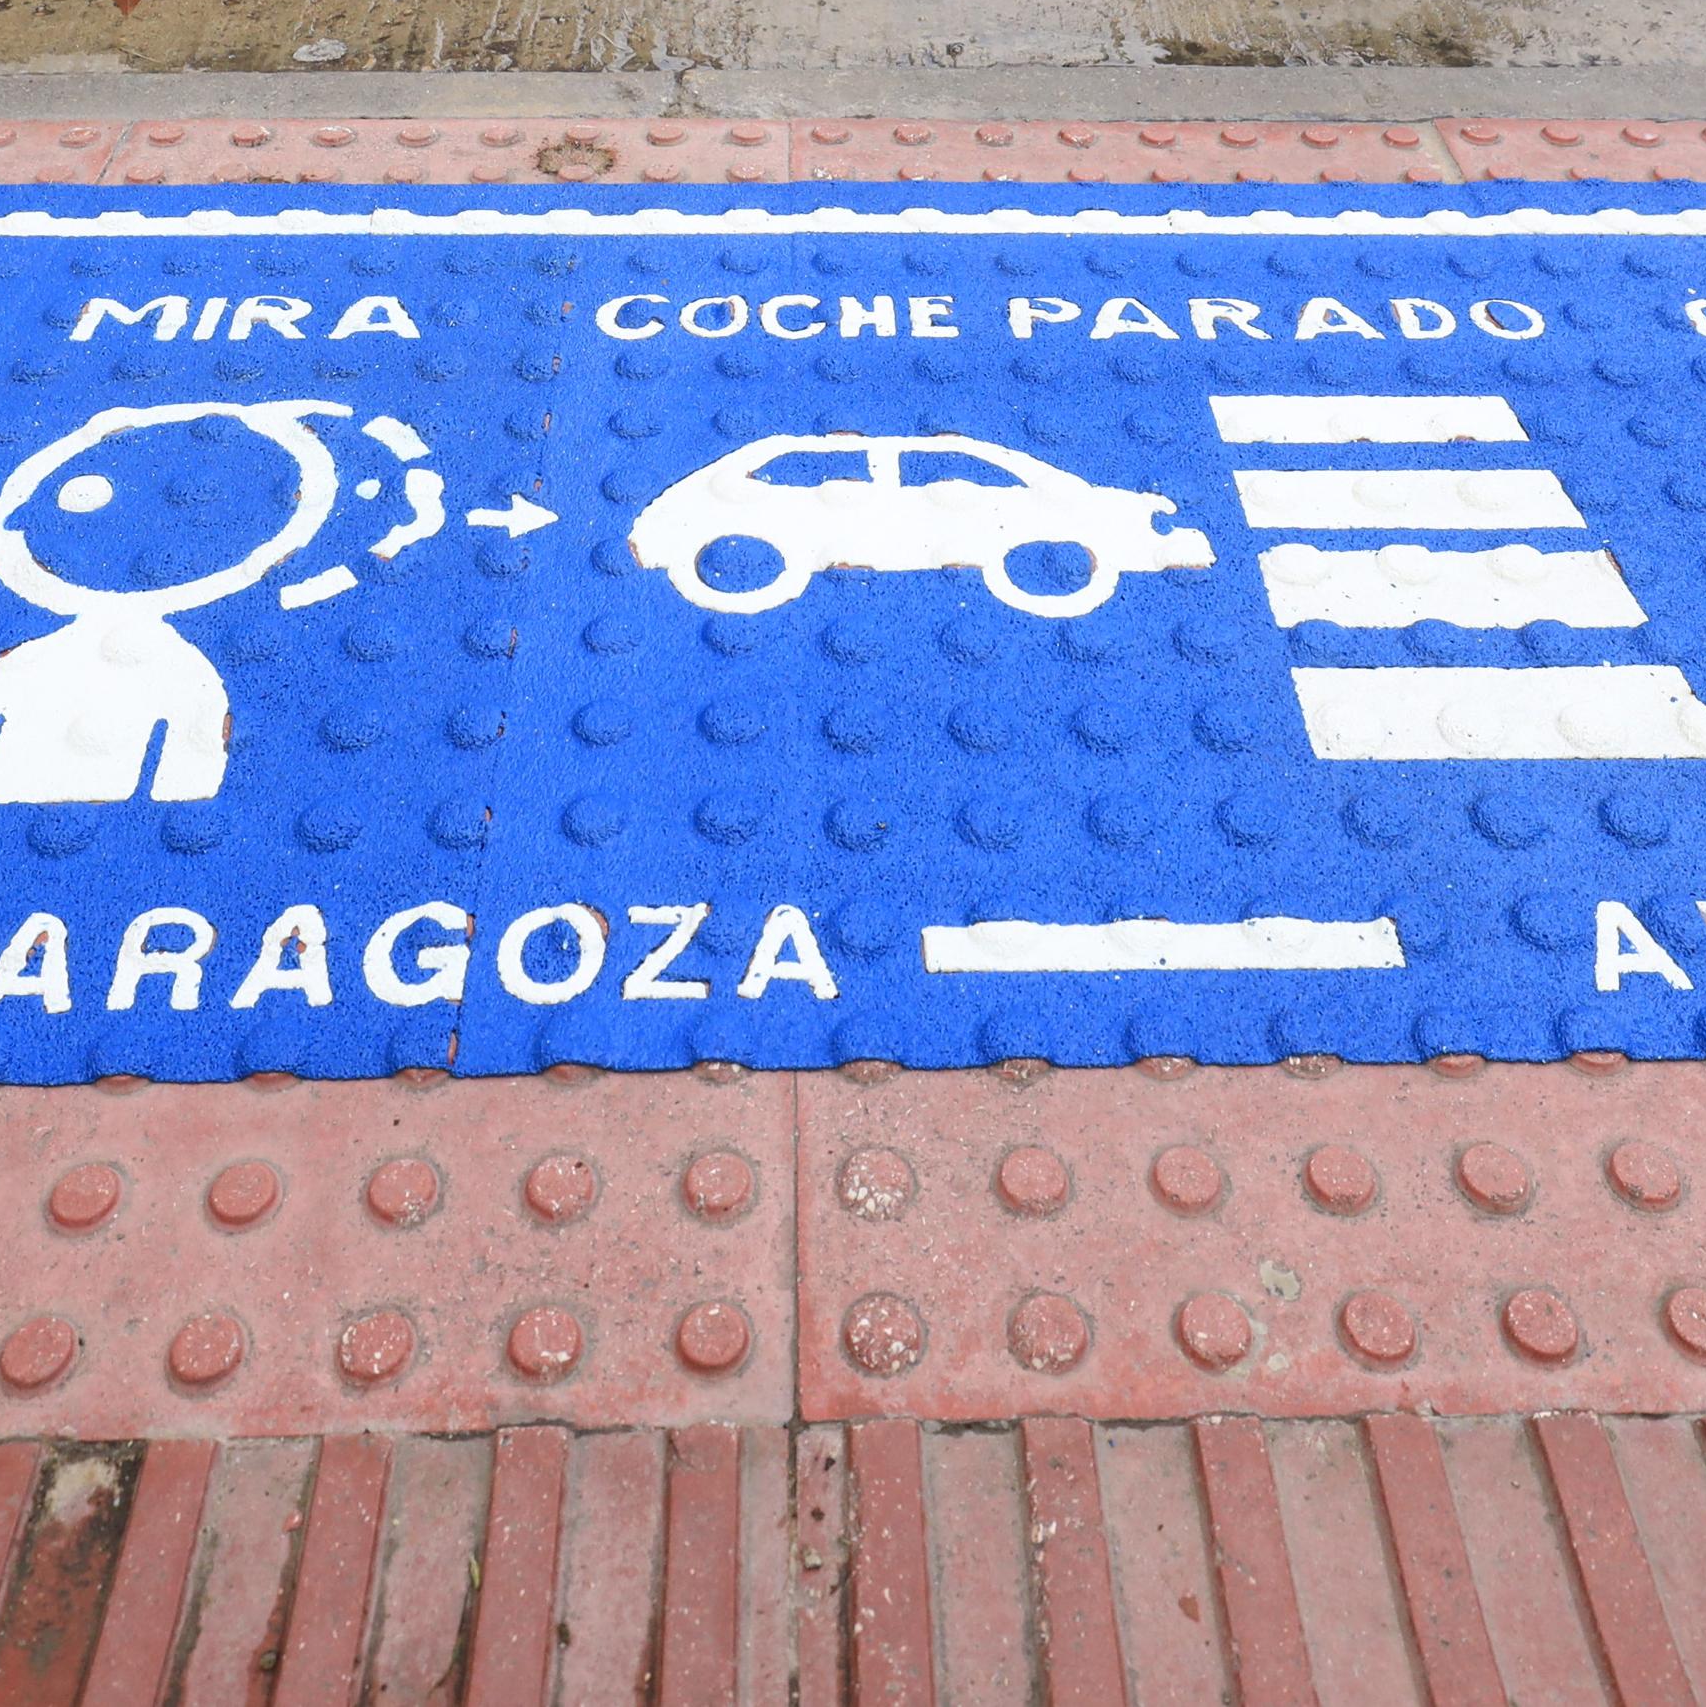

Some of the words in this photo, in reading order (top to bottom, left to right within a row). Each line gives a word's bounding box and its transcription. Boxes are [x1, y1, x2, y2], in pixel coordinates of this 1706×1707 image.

[68, 294, 421, 342] MIRA
[594, 293, 960, 341] COCHE
[1007, 296, 1547, 342] PARADO
